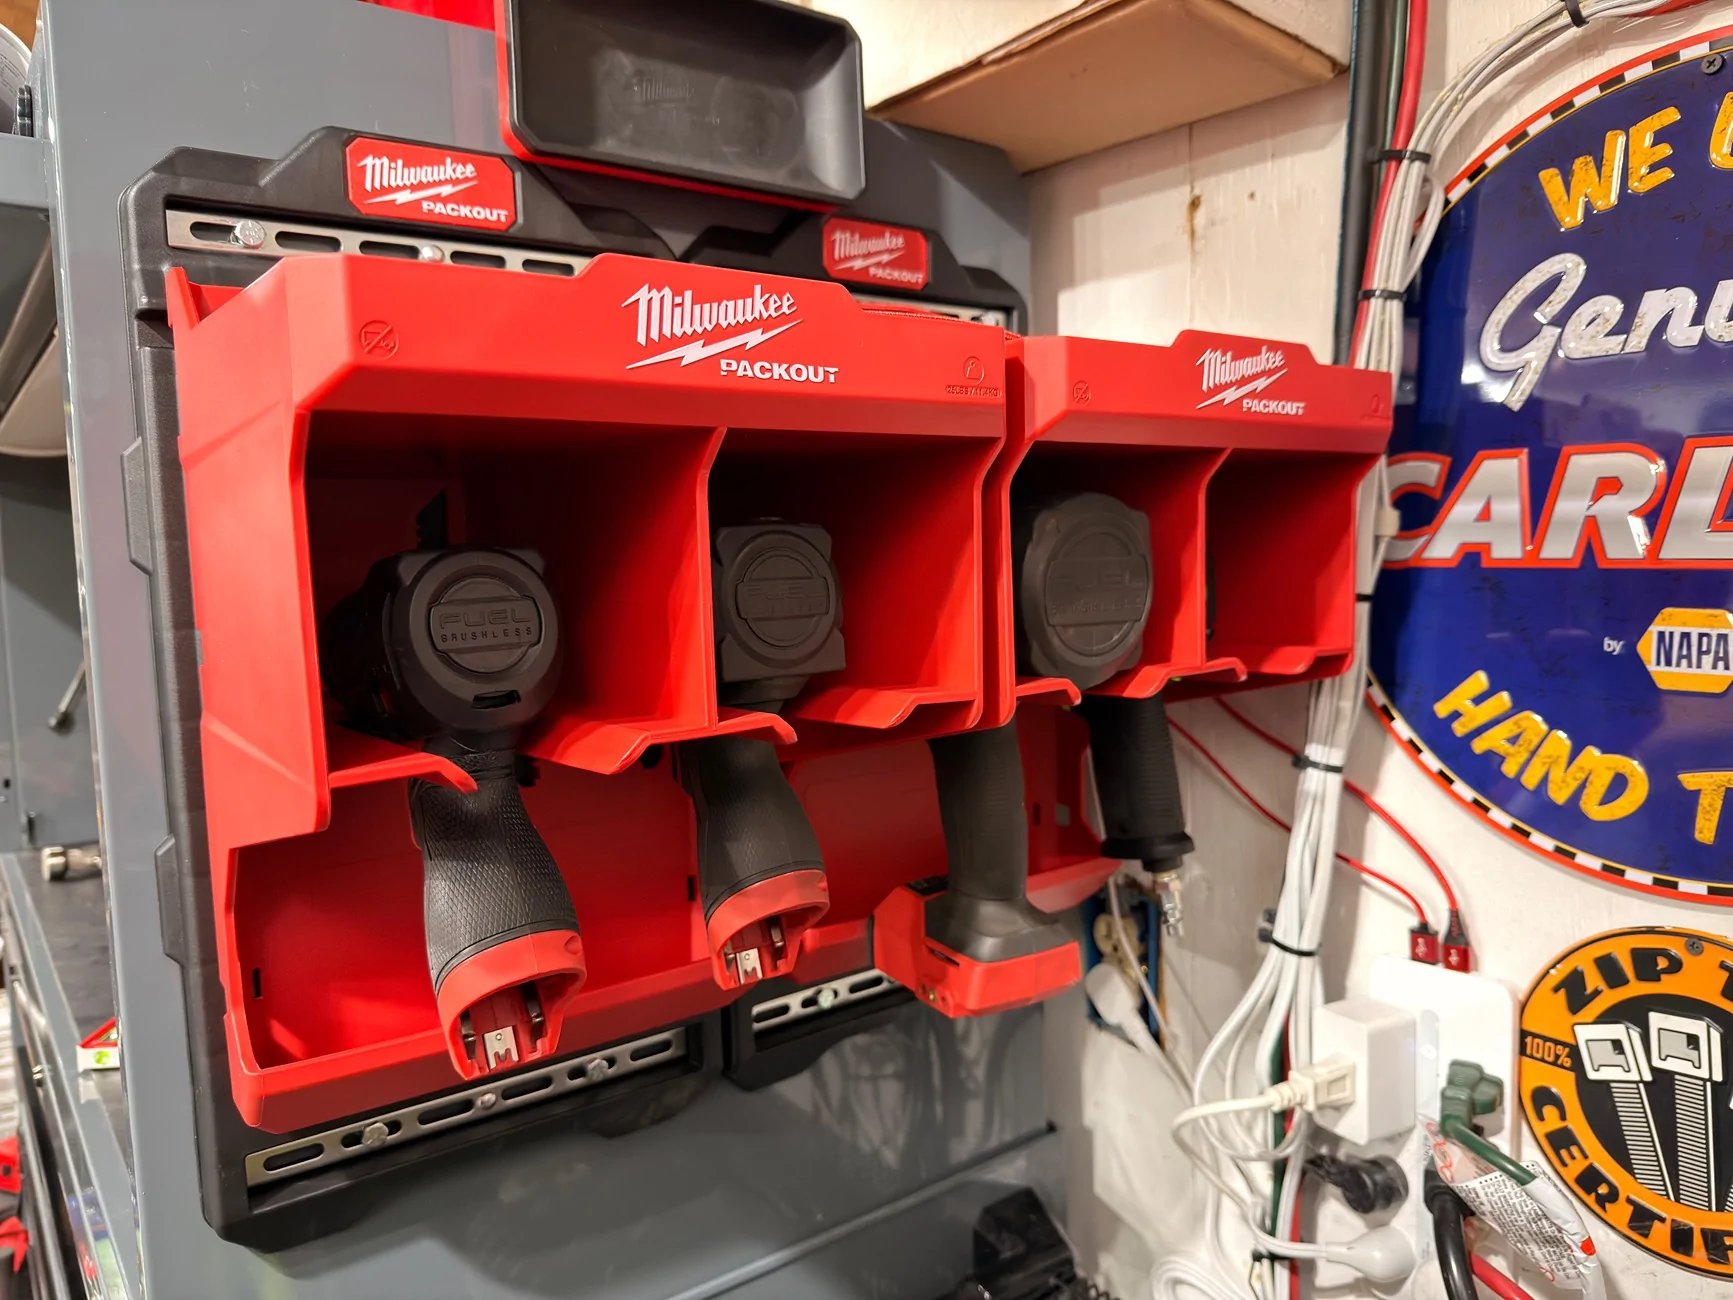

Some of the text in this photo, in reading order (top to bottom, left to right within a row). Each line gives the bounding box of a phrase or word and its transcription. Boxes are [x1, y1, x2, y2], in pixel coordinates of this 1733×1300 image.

[357, 154, 477, 192] Milwaukee
[1538, 106, 1681, 231] WE
[422, 200, 508, 222] PACKOUT
[831, 230, 905, 261] Milwaukee
[868, 266, 923, 284] PACKOUT
[621, 283, 797, 347] Milwaukee
[720, 358, 839, 383] PACKOUT
[1196, 345, 1285, 393] Milwaukee
[1242, 398, 1305, 416] PACKOUT
[439, 607, 532, 630] FUEL
[440, 626, 533, 643] BRUSHLESS
[1603, 630, 1731, 671] by NAPA
[1433, 670, 1649, 822] HAND
[1552, 948, 1683, 1015] ZIP
[1525, 1036, 1572, 1068] 100%
